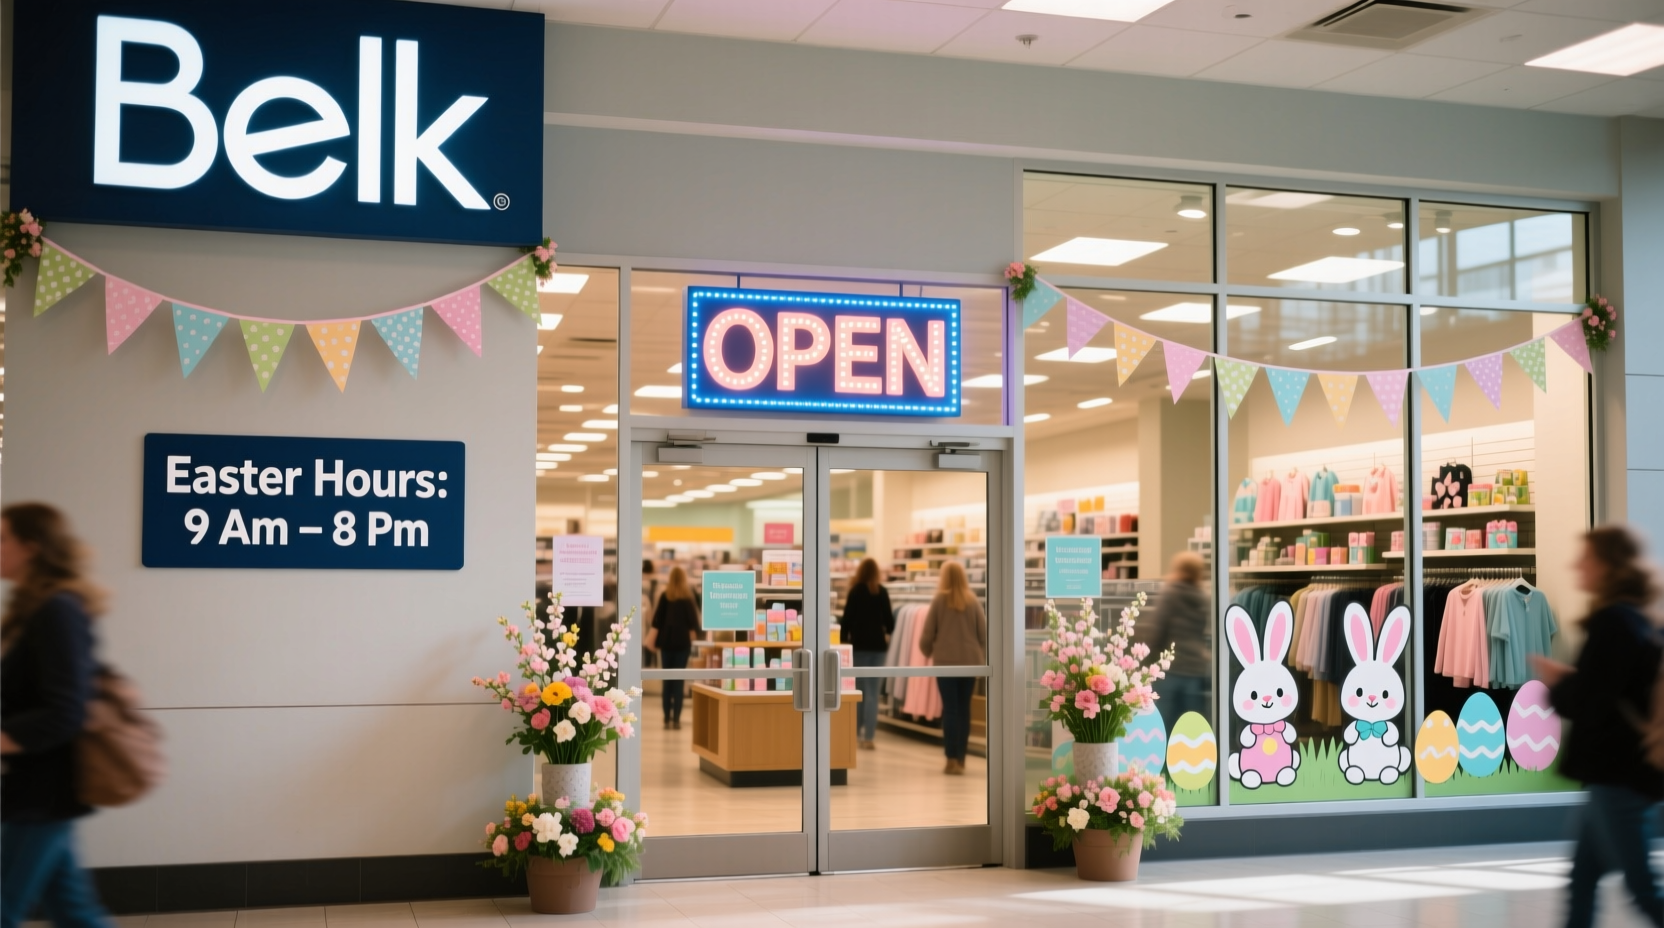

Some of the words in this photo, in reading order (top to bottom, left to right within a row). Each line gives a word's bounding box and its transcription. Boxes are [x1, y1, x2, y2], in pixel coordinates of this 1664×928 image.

[93, 15, 491, 210] Belk
[703, 308, 945, 398] OPEN
[166, 455, 303, 496] Easter
[314, 458, 448, 499] Hours:
[184, 508, 210, 545] 9
[218, 508, 288, 546] Am
[332, 510, 357, 547] 8
[368, 511, 429, 547] Pm
